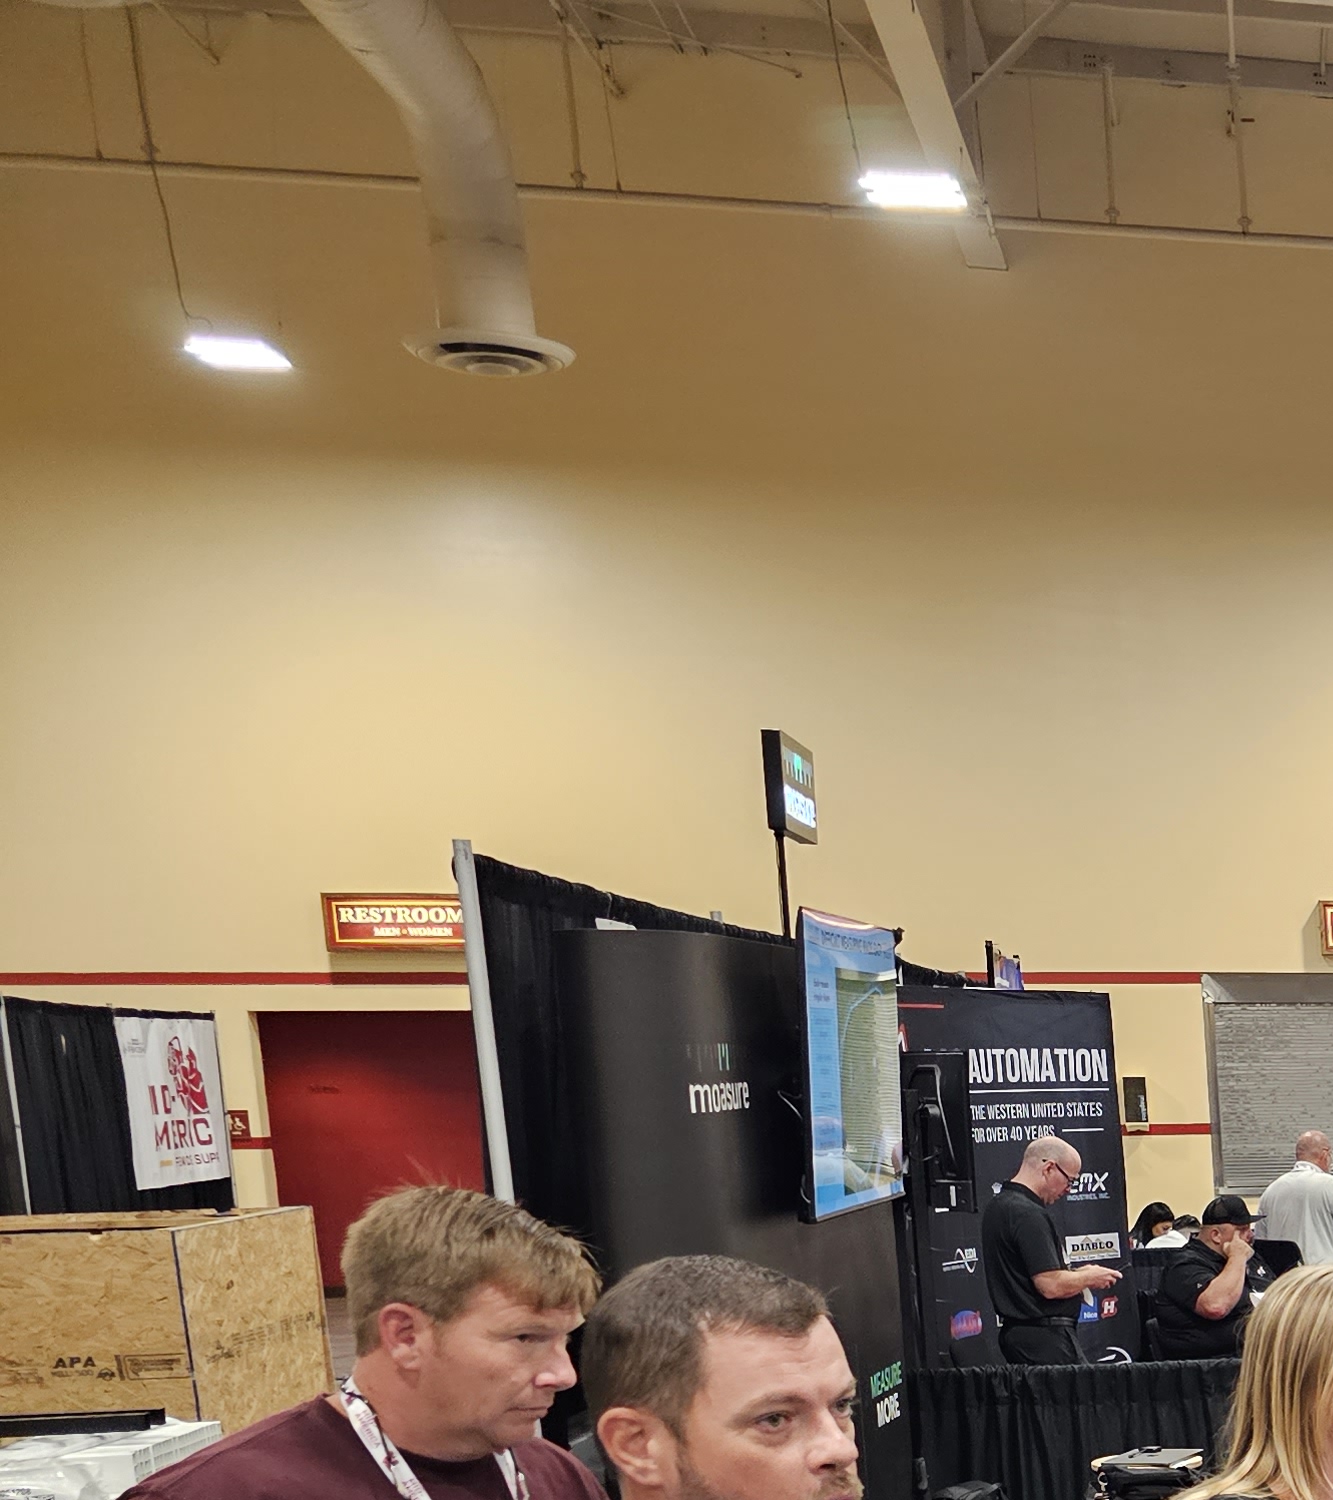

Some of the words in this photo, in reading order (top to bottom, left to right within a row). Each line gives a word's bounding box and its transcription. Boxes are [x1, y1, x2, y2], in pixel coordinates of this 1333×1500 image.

[373, 927, 400, 937] MEN
[408, 927, 453, 937] WOMEN
[968, 1048, 1109, 1083] AUTOMATION
[689, 1082, 750, 1113] moasure
[970, 1104, 986, 1121] THE
[986, 1103, 1030, 1120] WESTERN
[1031, 1102, 1065, 1118] UNITED
[1066, 1101, 1103, 1117] STATES
[986, 1127, 1009, 1143] OVER
[1010, 1126, 1022, 1141] 40
[1071, 1241, 1114, 1252] DIABLO
[53, 1356, 96, 1369] APA
[870, 1361, 902, 1399] MEASURE
[876, 1392, 901, 1427] MORE
